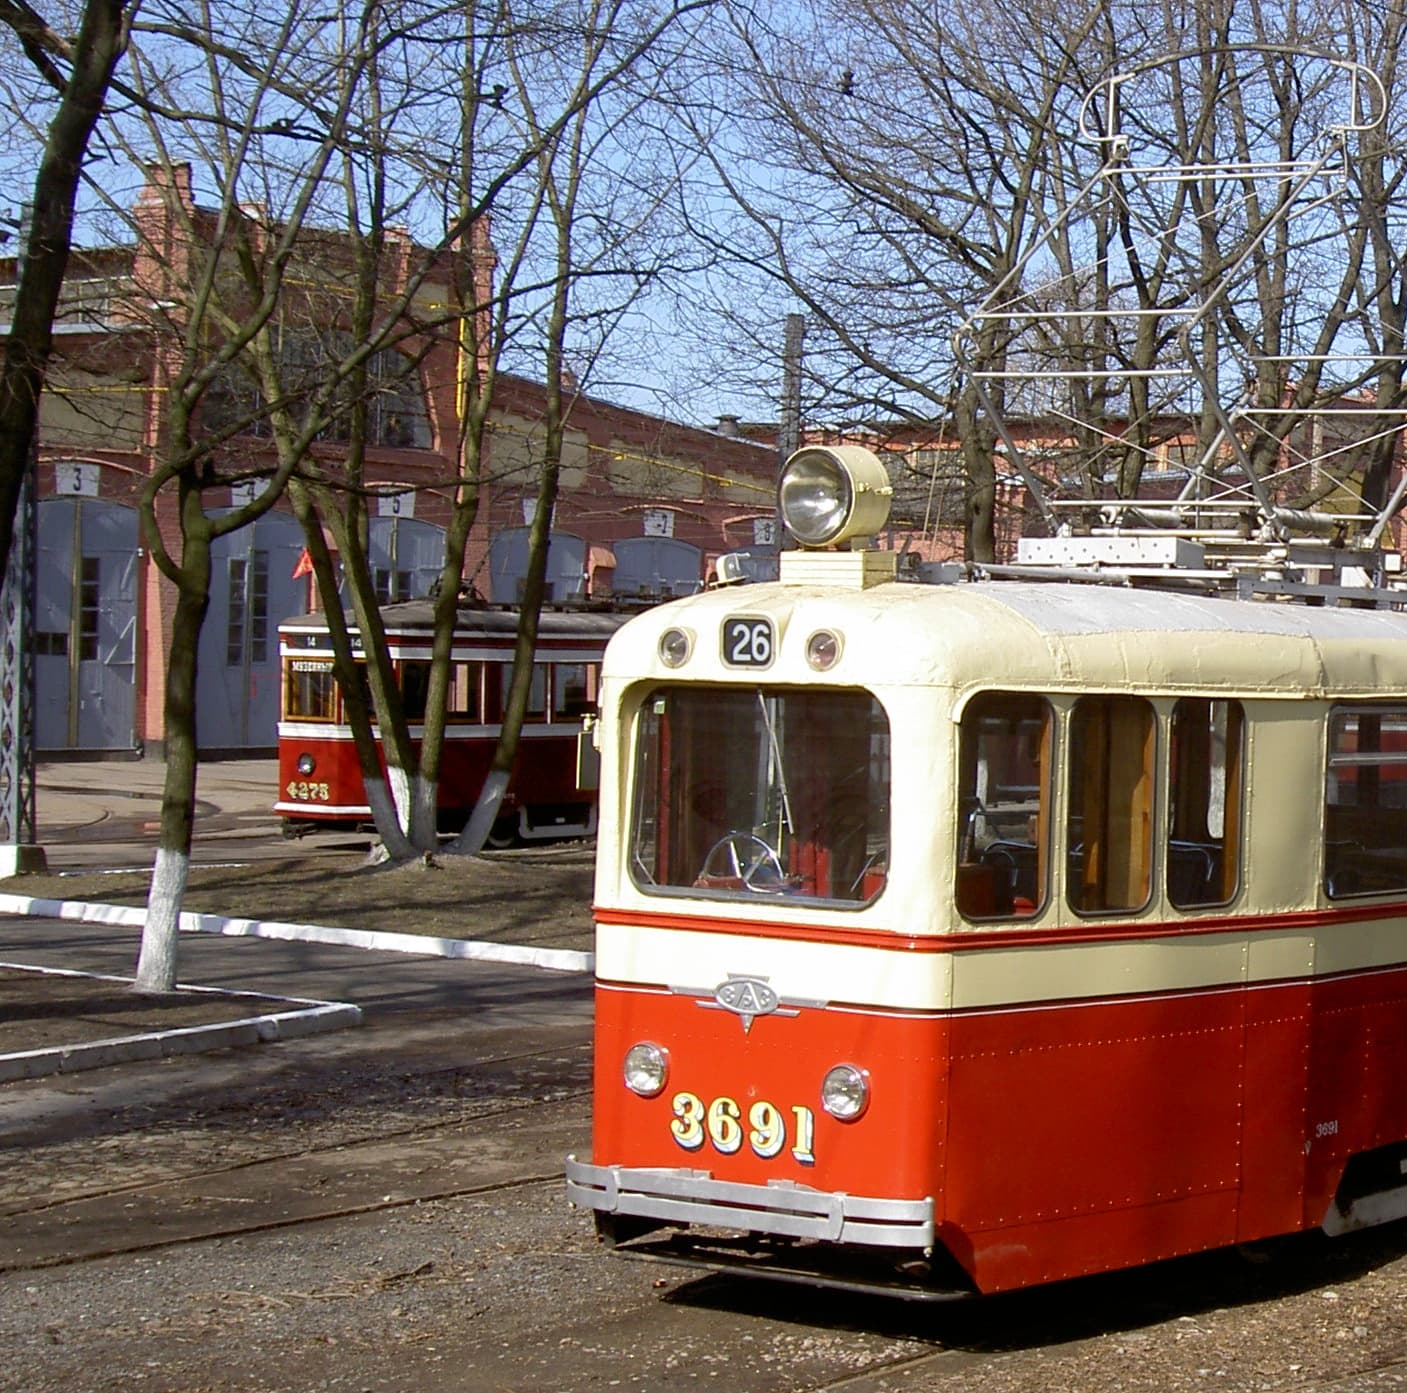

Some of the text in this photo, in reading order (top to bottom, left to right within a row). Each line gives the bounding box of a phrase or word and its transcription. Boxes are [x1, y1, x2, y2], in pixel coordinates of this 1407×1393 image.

[73, 467, 82, 492] 3
[732, 623, 770, 661] 26
[286, 781, 329, 800] 4275
[670, 1091, 815, 1166] 3691
[1315, 1119, 1338, 1138] 3691
